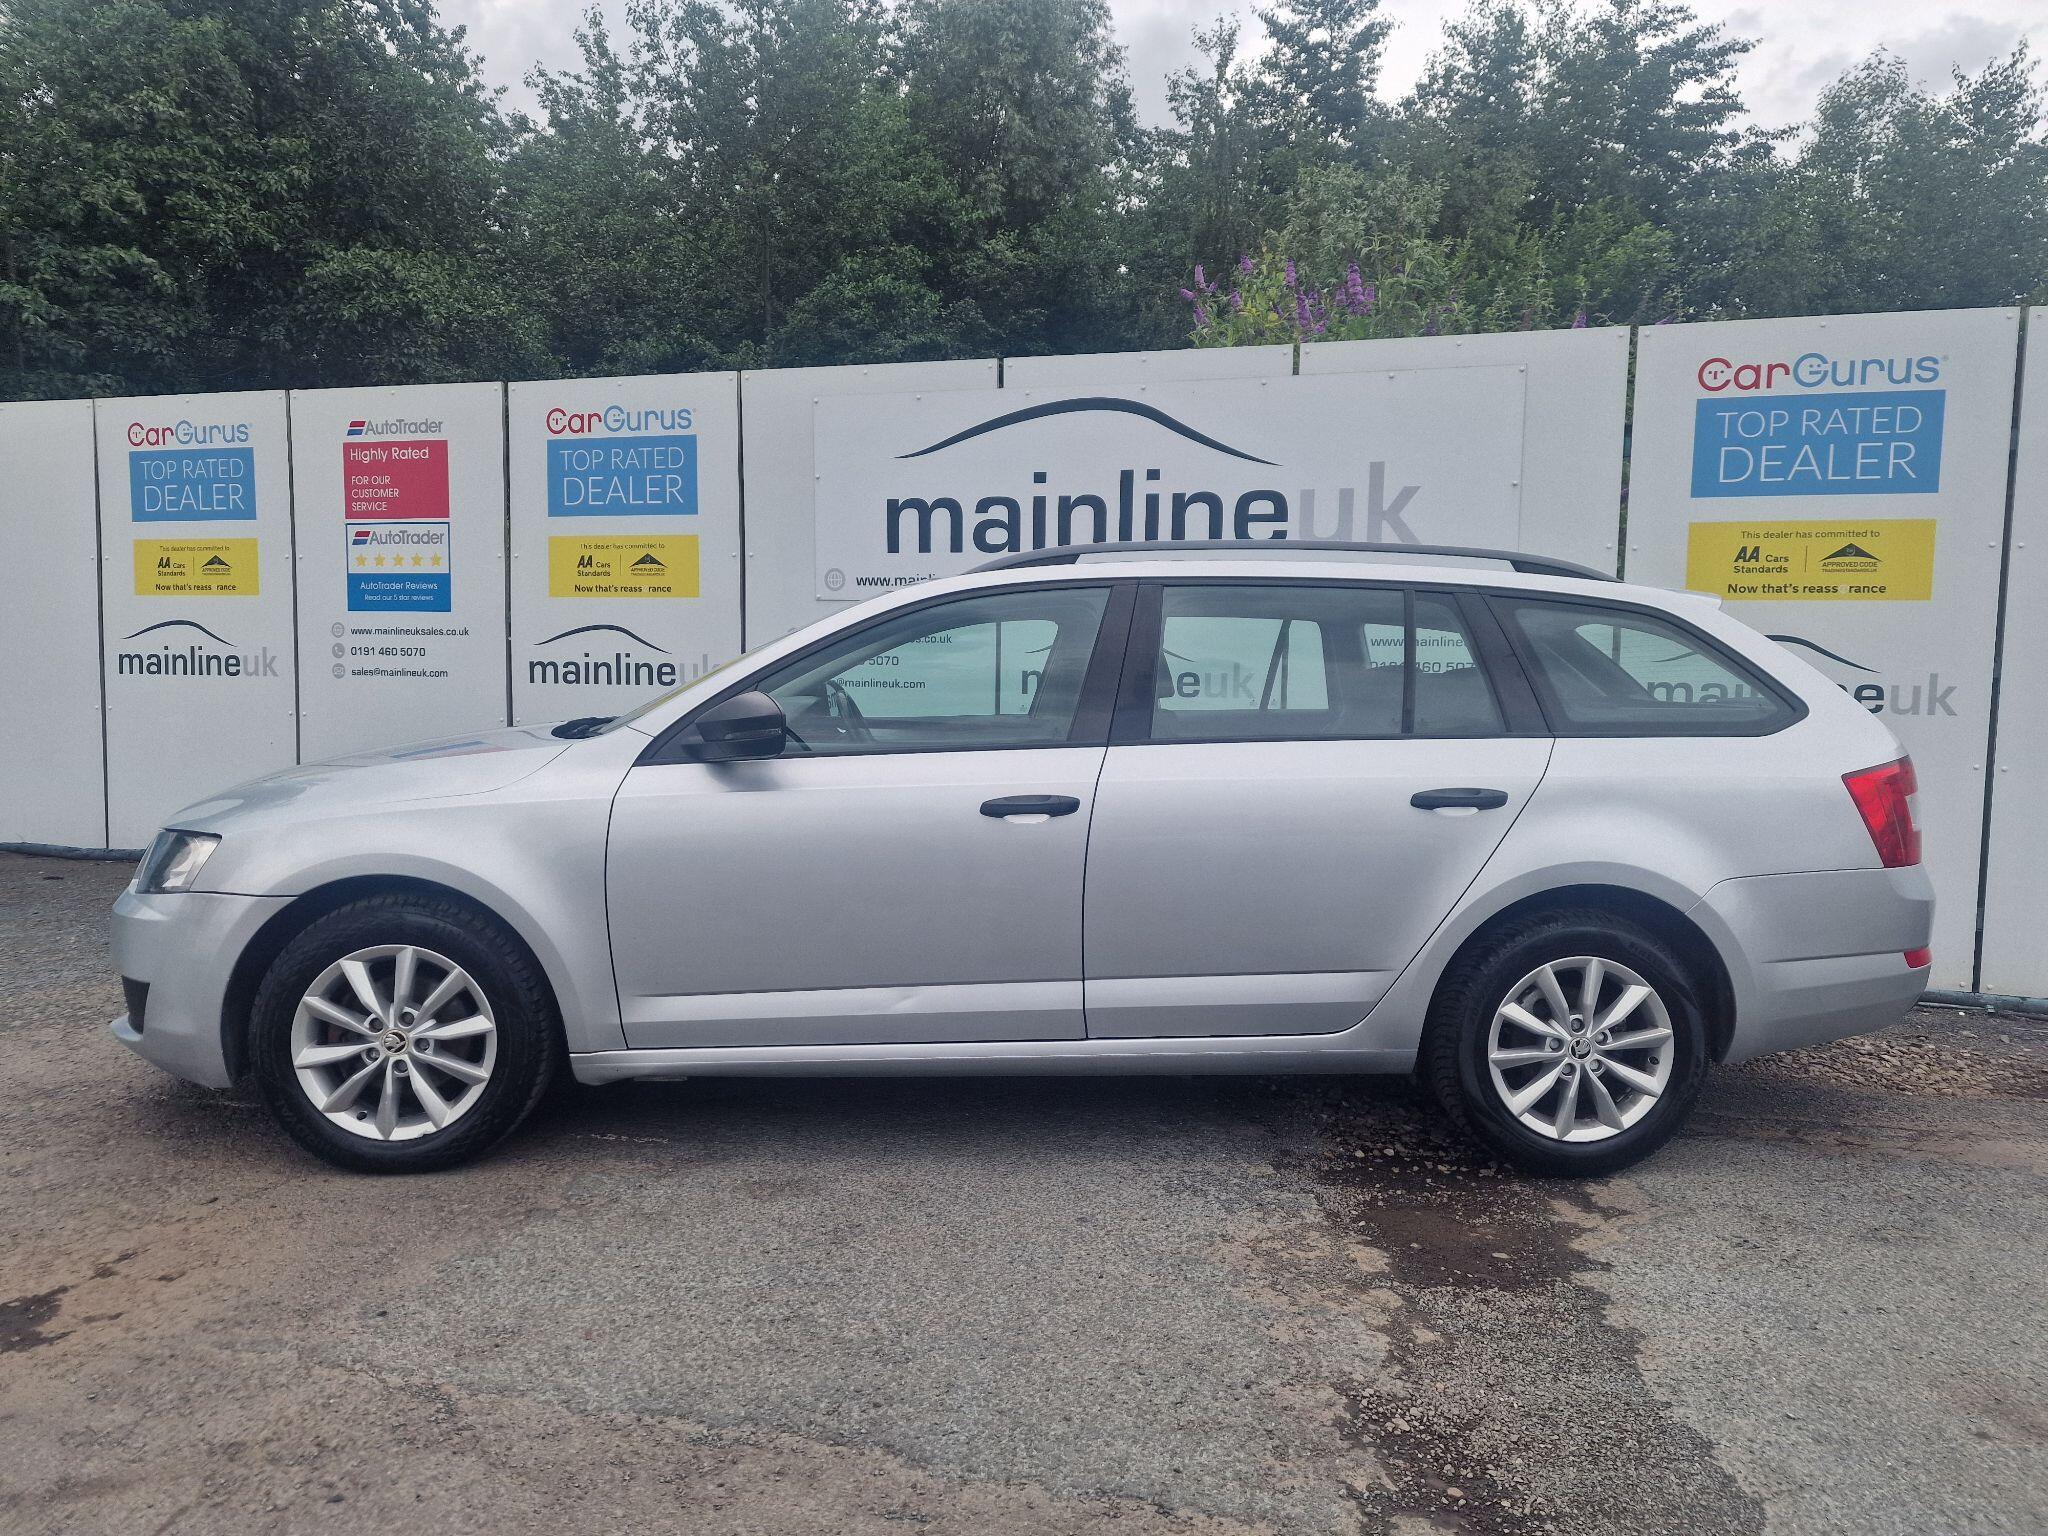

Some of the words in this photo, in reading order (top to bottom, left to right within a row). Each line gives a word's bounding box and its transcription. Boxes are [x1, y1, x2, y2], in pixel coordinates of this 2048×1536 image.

[1697, 352, 1940, 392] CarGurus
[365, 418, 443, 435] AutoTrader
[545, 405, 692, 435] CarGurus
[1716, 410, 1789, 439] TOP
[1801, 406, 1922, 436] RATED
[127, 420, 250, 447] CarGurus
[350, 447, 388, 463] Highly
[391, 446, 429, 460] Rated
[559, 449, 604, 471] TOP
[611, 446, 684, 471] RATED
[141, 461, 177, 480] TOP
[183, 458, 243, 480] RATED
[1718, 442, 1917, 483] DEALER
[351, 475, 369, 485] FOR
[371, 475, 391, 485] OUR
[351, 488, 400, 498] CUSTOMER
[563, 474, 684, 505] DEALER
[144, 484, 245, 511] DEALER
[351, 501, 388, 511] SERVICE
[369, 530, 444, 546] AutoTrader
[1741, 531, 1761, 539] This
[1763, 530, 1794, 539] dealer
[1795, 530, 1813, 539] has
[1815, 529, 1868, 538] committed
[1870, 530, 1881, 538] to
[1733, 545, 1761, 563] AA
[1765, 555, 1790, 563] Cars
[157, 556, 171, 569] AA
[577, 555, 593, 568] AA
[1733, 565, 1789, 574] Standards
[155, 583, 171, 591] Now
[172, 583, 192, 591] that's
[360, 581, 404, 590] AutoTrader
[405, 581, 438, 590] Reviews
[574, 584, 593, 592] Now
[595, 584, 618, 592] that's
[1727, 583, 1758, 594] Now
[1762, 583, 1799, 594] that's
[350, 626, 470, 636] www.mainlineuksales.co.uk
[350, 646, 375, 656] 0191
[378, 647, 397, 656] 460
[400, 647, 426, 657] 5070
[118, 646, 279, 677] mainlineuk
[868, 656, 899, 666] 5070
[351, 667, 448, 678] sales@mainlineuk.com
[837, 678, 926, 689] @mainlineuk.com
